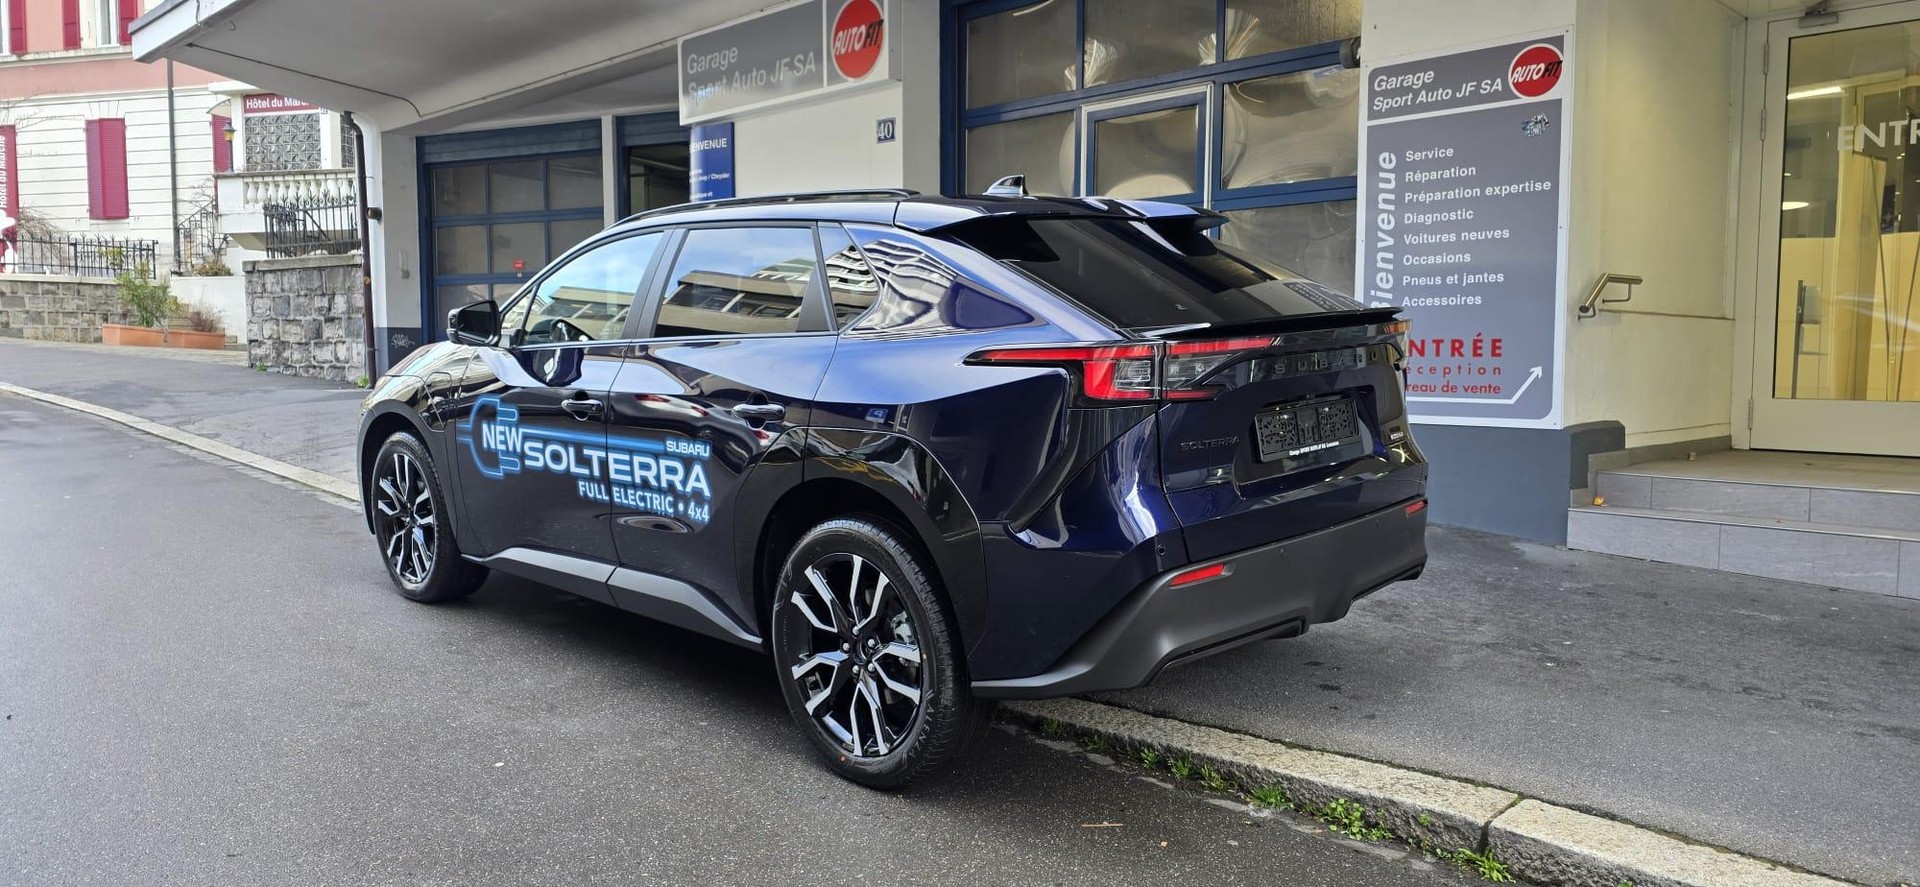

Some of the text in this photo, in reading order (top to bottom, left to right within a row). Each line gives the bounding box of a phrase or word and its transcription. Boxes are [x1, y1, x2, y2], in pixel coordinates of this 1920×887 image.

[834, 19, 884, 56] AUTOFIT
[687, 47, 738, 74] Garage
[731, 69, 766, 92] Auto
[794, 51, 816, 77] SA
[1512, 60, 1563, 83] AUTOFIT
[1374, 70, 1435, 94] Garage
[246, 98, 270, 109] Hôtel
[271, 97, 283, 107] du
[1373, 77, 1502, 112] Sport Auto JF SA
[878, 121, 893, 139] 40
[1405, 148, 1454, 162] Service
[1405, 166, 1476, 183] Réparation
[1405, 180, 1552, 204] Préparation expertise
[1404, 209, 1474, 225] Diagnostic
[1404, 228, 1510, 245] Voitures neuves
[1403, 252, 1471, 266] Occasions
[1403, 273, 1505, 287] Pneus et jantes
[1402, 295, 1482, 307] Accessoires
[1409, 332, 1502, 357] NTRÉE
[1274, 350, 1377, 374] SUBARU
[1406, 363, 1502, 378] éception
[1406, 380, 1502, 394] reau de vente
[482, 423, 523, 453] NEW
[1180, 436, 1240, 451] SOLTERRA
[666, 440, 710, 457] SUBARU
[523, 440, 711, 497] SOLTERRA
[578, 480, 711, 522] FULL ELECTRIC 4x4
